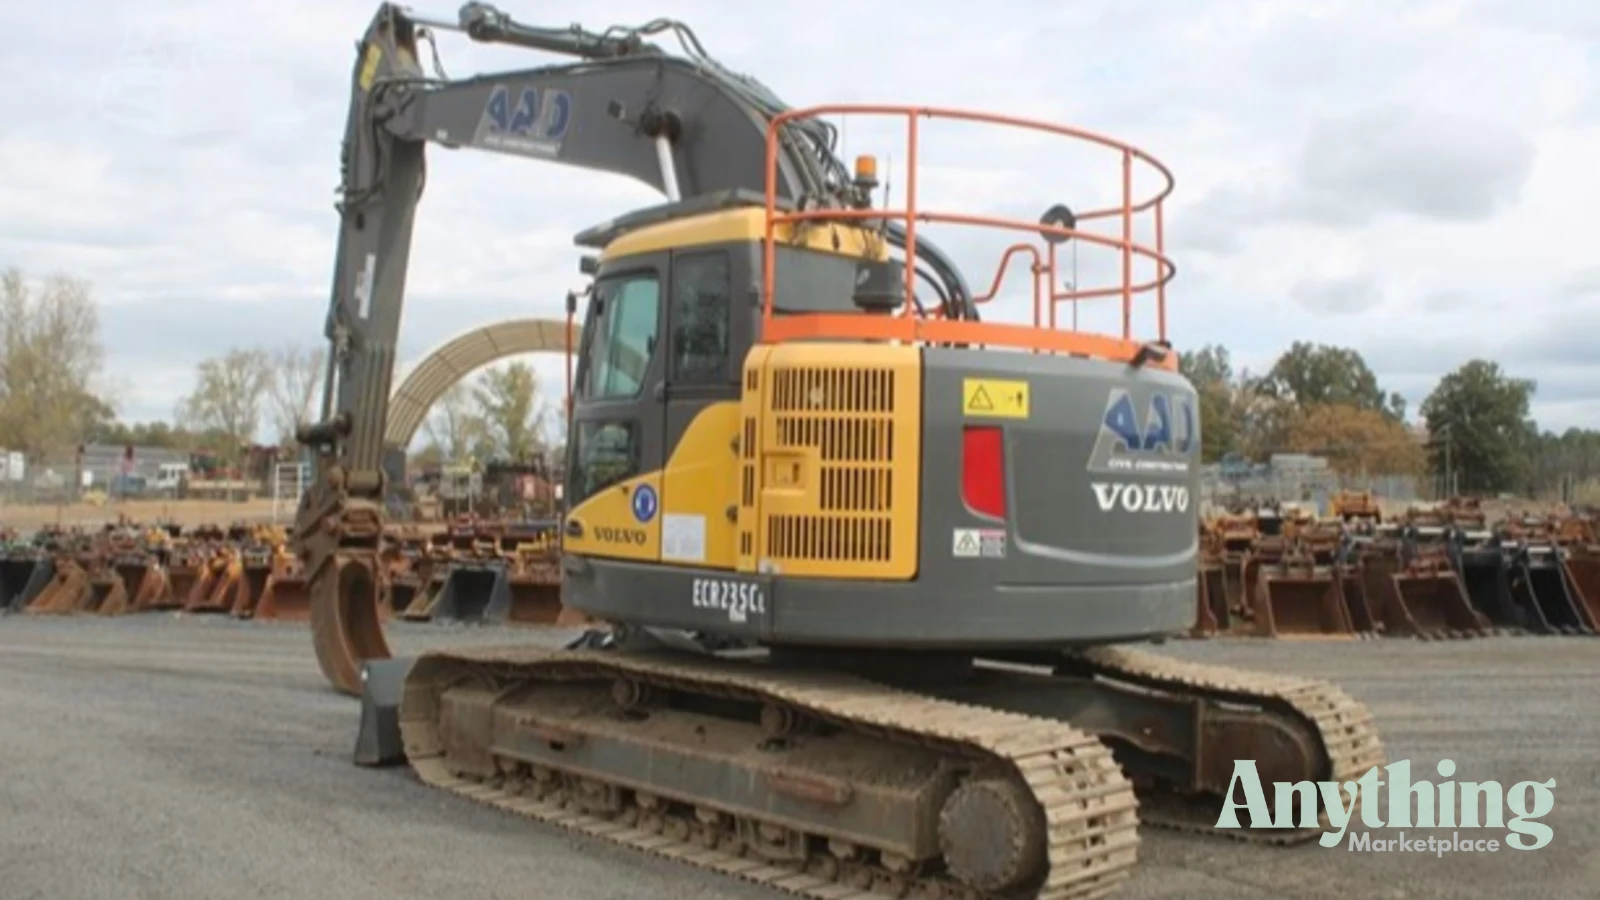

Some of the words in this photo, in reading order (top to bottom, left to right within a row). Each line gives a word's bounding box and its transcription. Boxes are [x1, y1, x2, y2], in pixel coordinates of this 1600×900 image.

[1088, 388, 1199, 455] AAD
[1091, 482, 1189, 512] VOLVO
[594, 526, 647, 546] VOLVO
